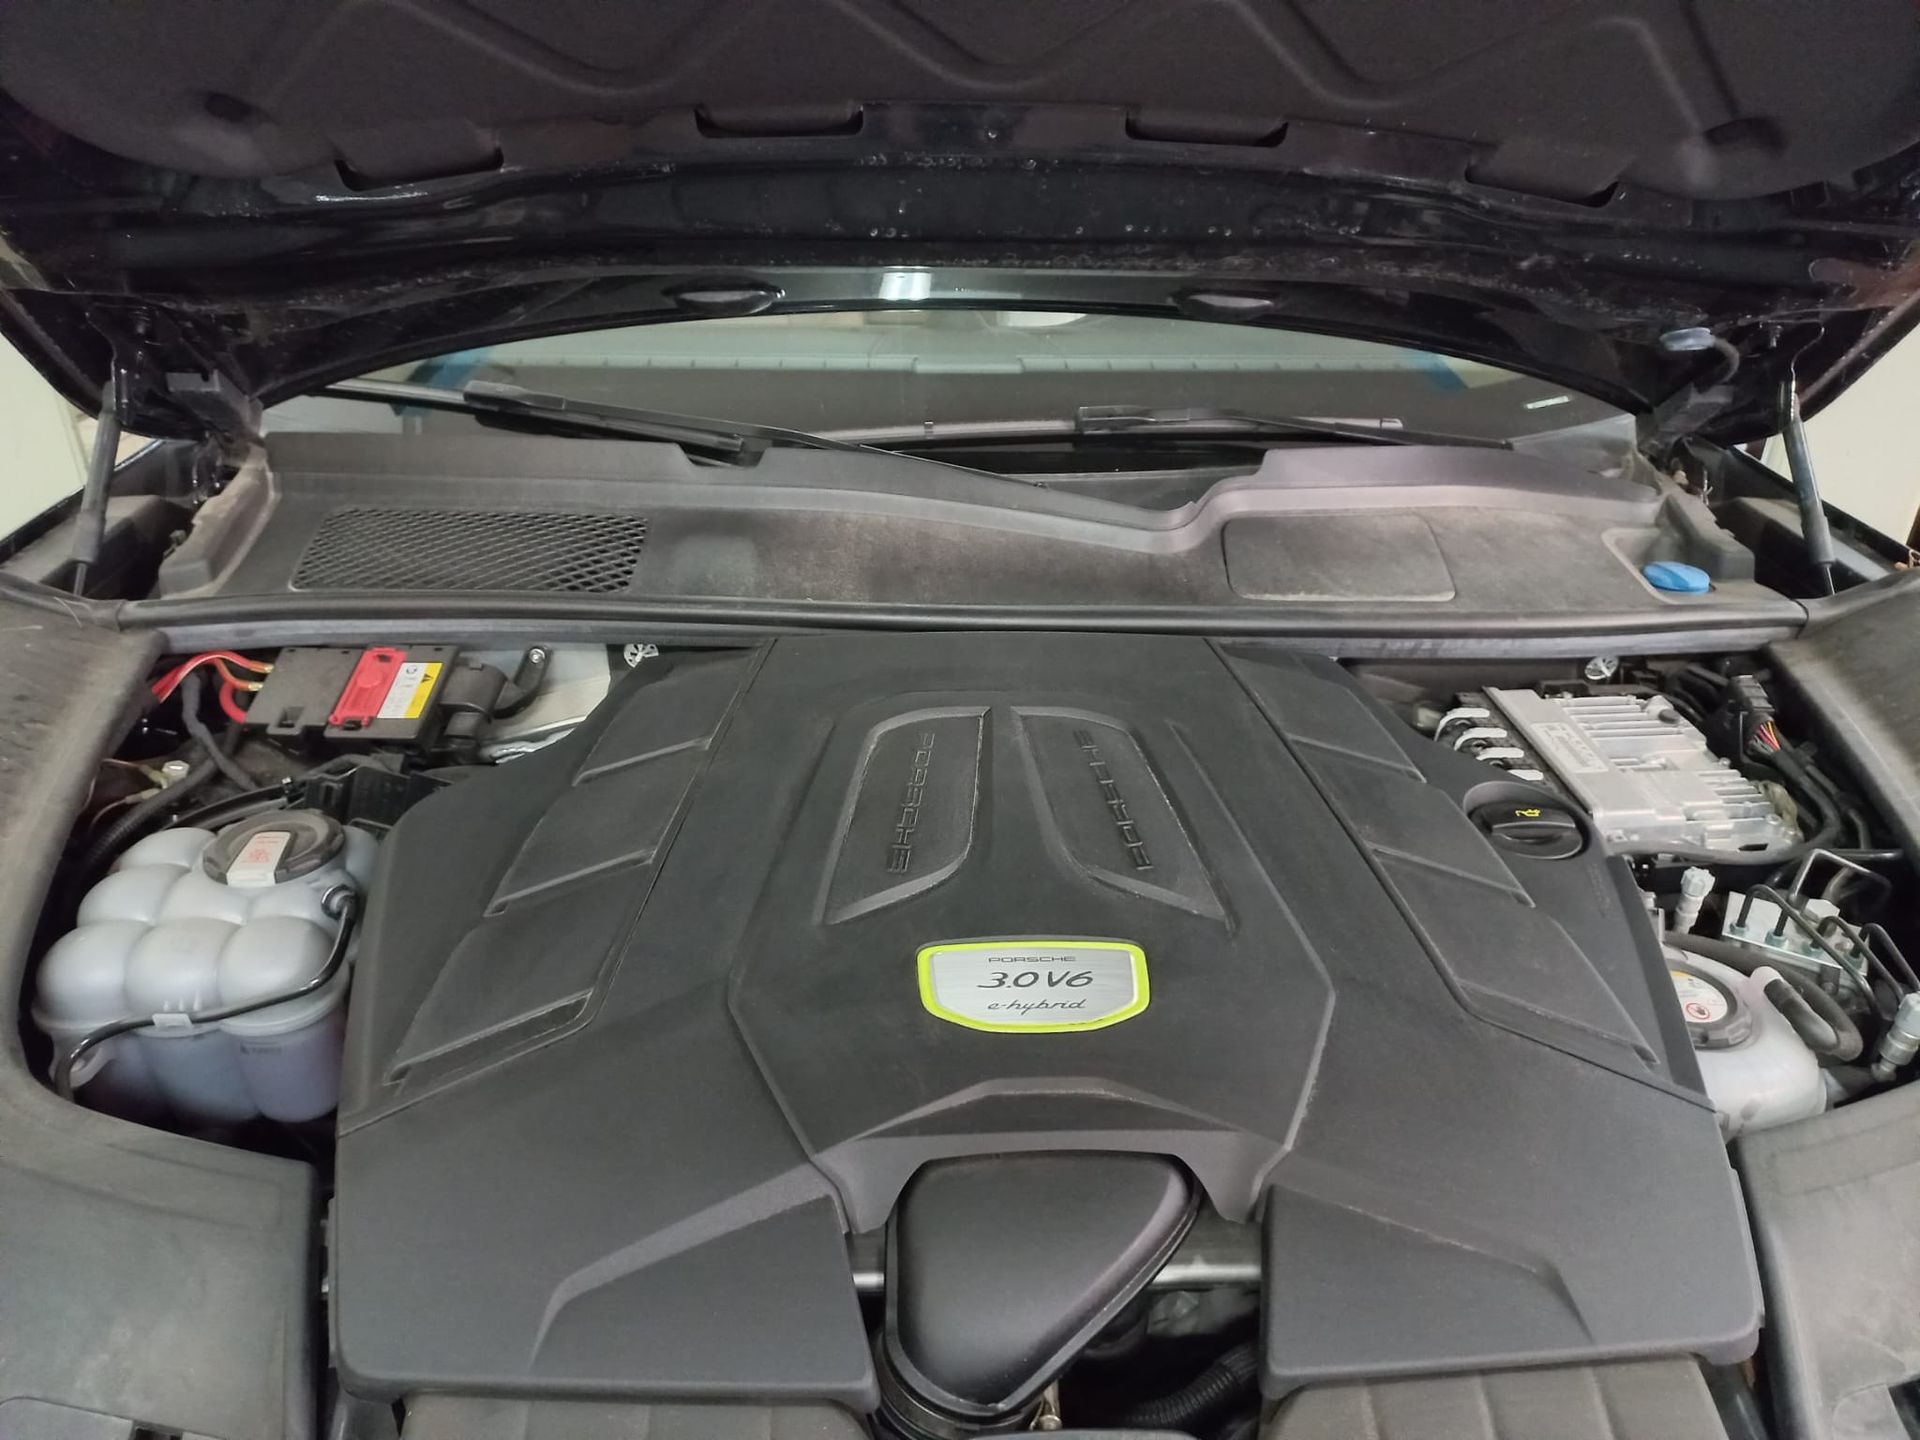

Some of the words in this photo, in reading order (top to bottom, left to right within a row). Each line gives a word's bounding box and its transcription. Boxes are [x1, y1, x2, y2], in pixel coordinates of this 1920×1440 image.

[886, 733, 936, 874] PORSCHE
[1073, 730, 1154, 870] PORSCHE
[976, 971, 1040, 989] 3.0
[1047, 970, 1094, 988] V6
[987, 998, 1088, 1016] e-hybrid
